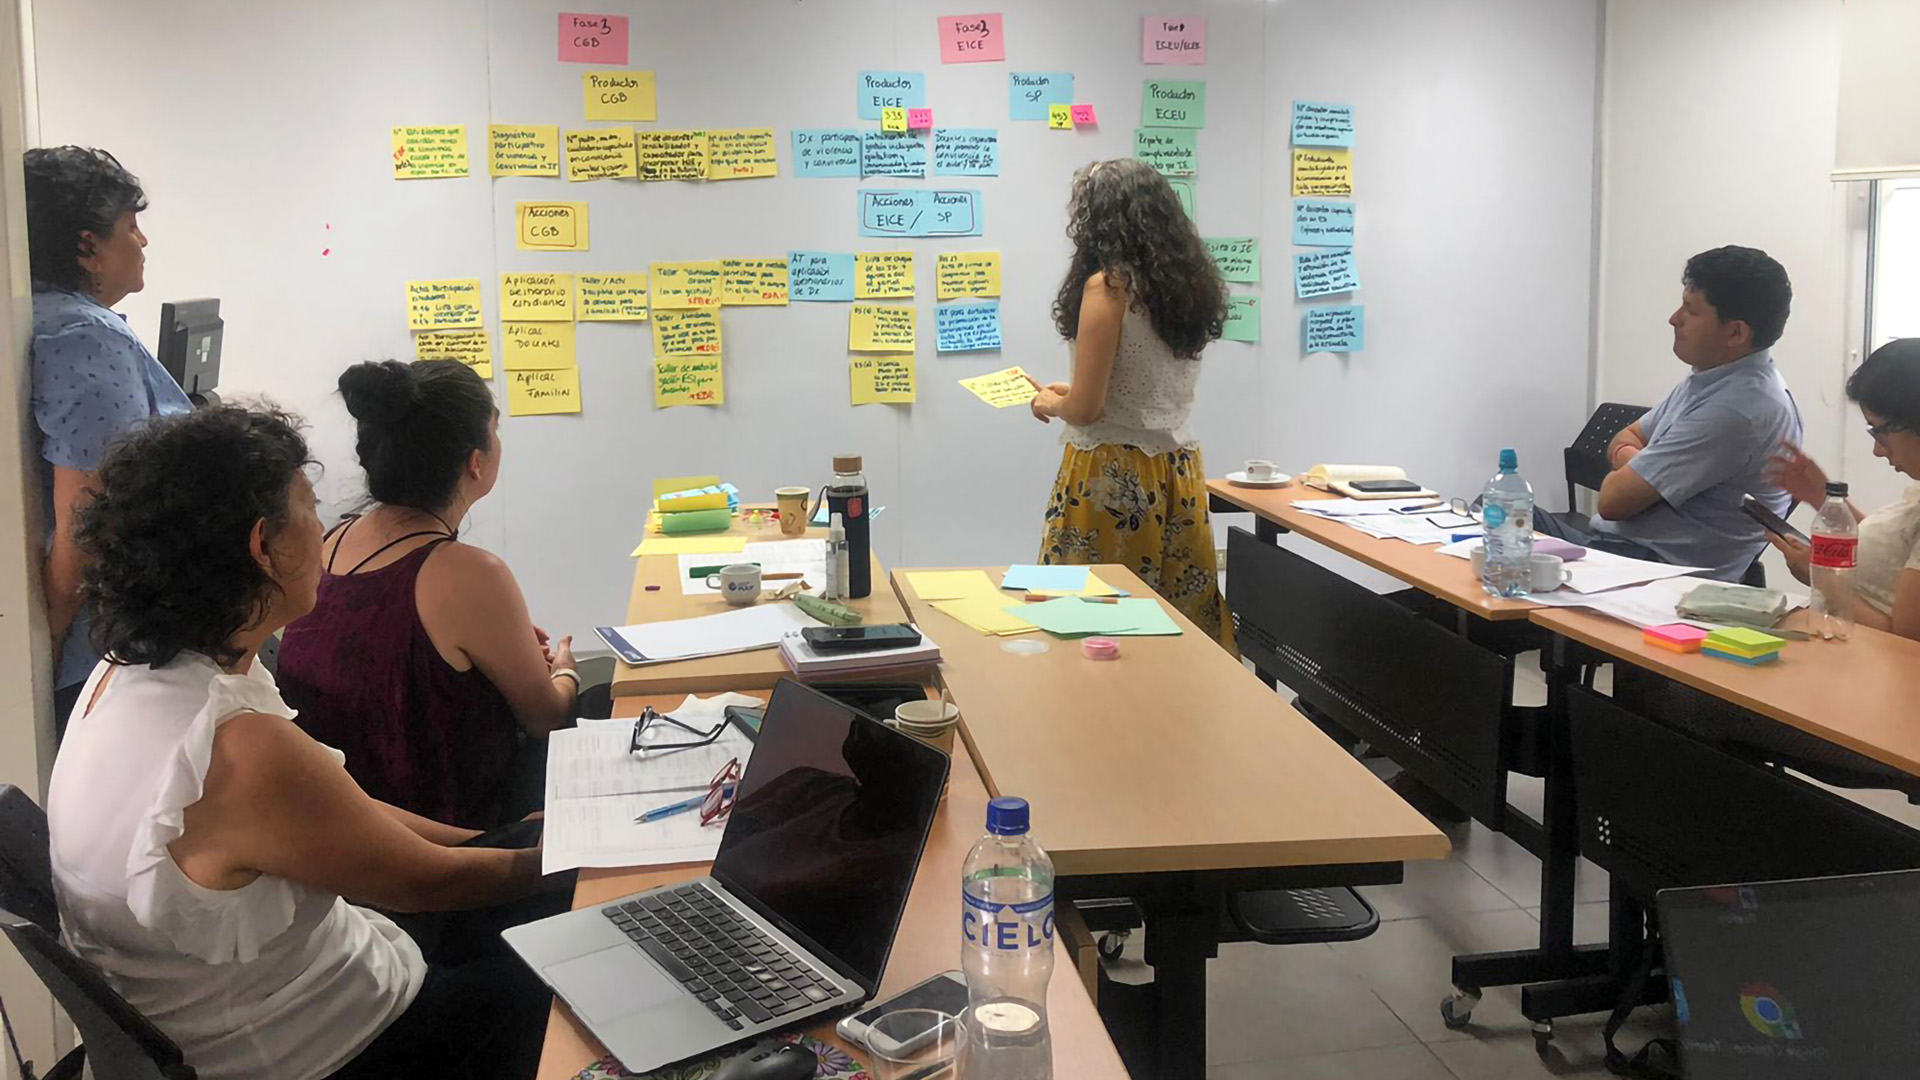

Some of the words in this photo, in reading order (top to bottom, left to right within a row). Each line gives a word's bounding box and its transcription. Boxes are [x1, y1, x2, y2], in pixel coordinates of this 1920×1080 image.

[573, 37, 600, 48] CGB
[957, 40, 984, 51] EICE
[865, 75, 912, 93] Productos
[1149, 83, 1196, 100] Productos
[601, 92, 628, 105] CGB
[873, 96, 903, 107] EICE
[1155, 107, 1186, 120] ECEU
[872, 194, 914, 208] Acciones
[932, 192, 968, 206] Acciones
[528, 207, 569, 218] Acciones
[876, 214, 905, 227] EICE
[530, 225, 560, 237] CGB
[505, 274, 556, 287] Aplicación
[962, 911, 1055, 950] CIELO
